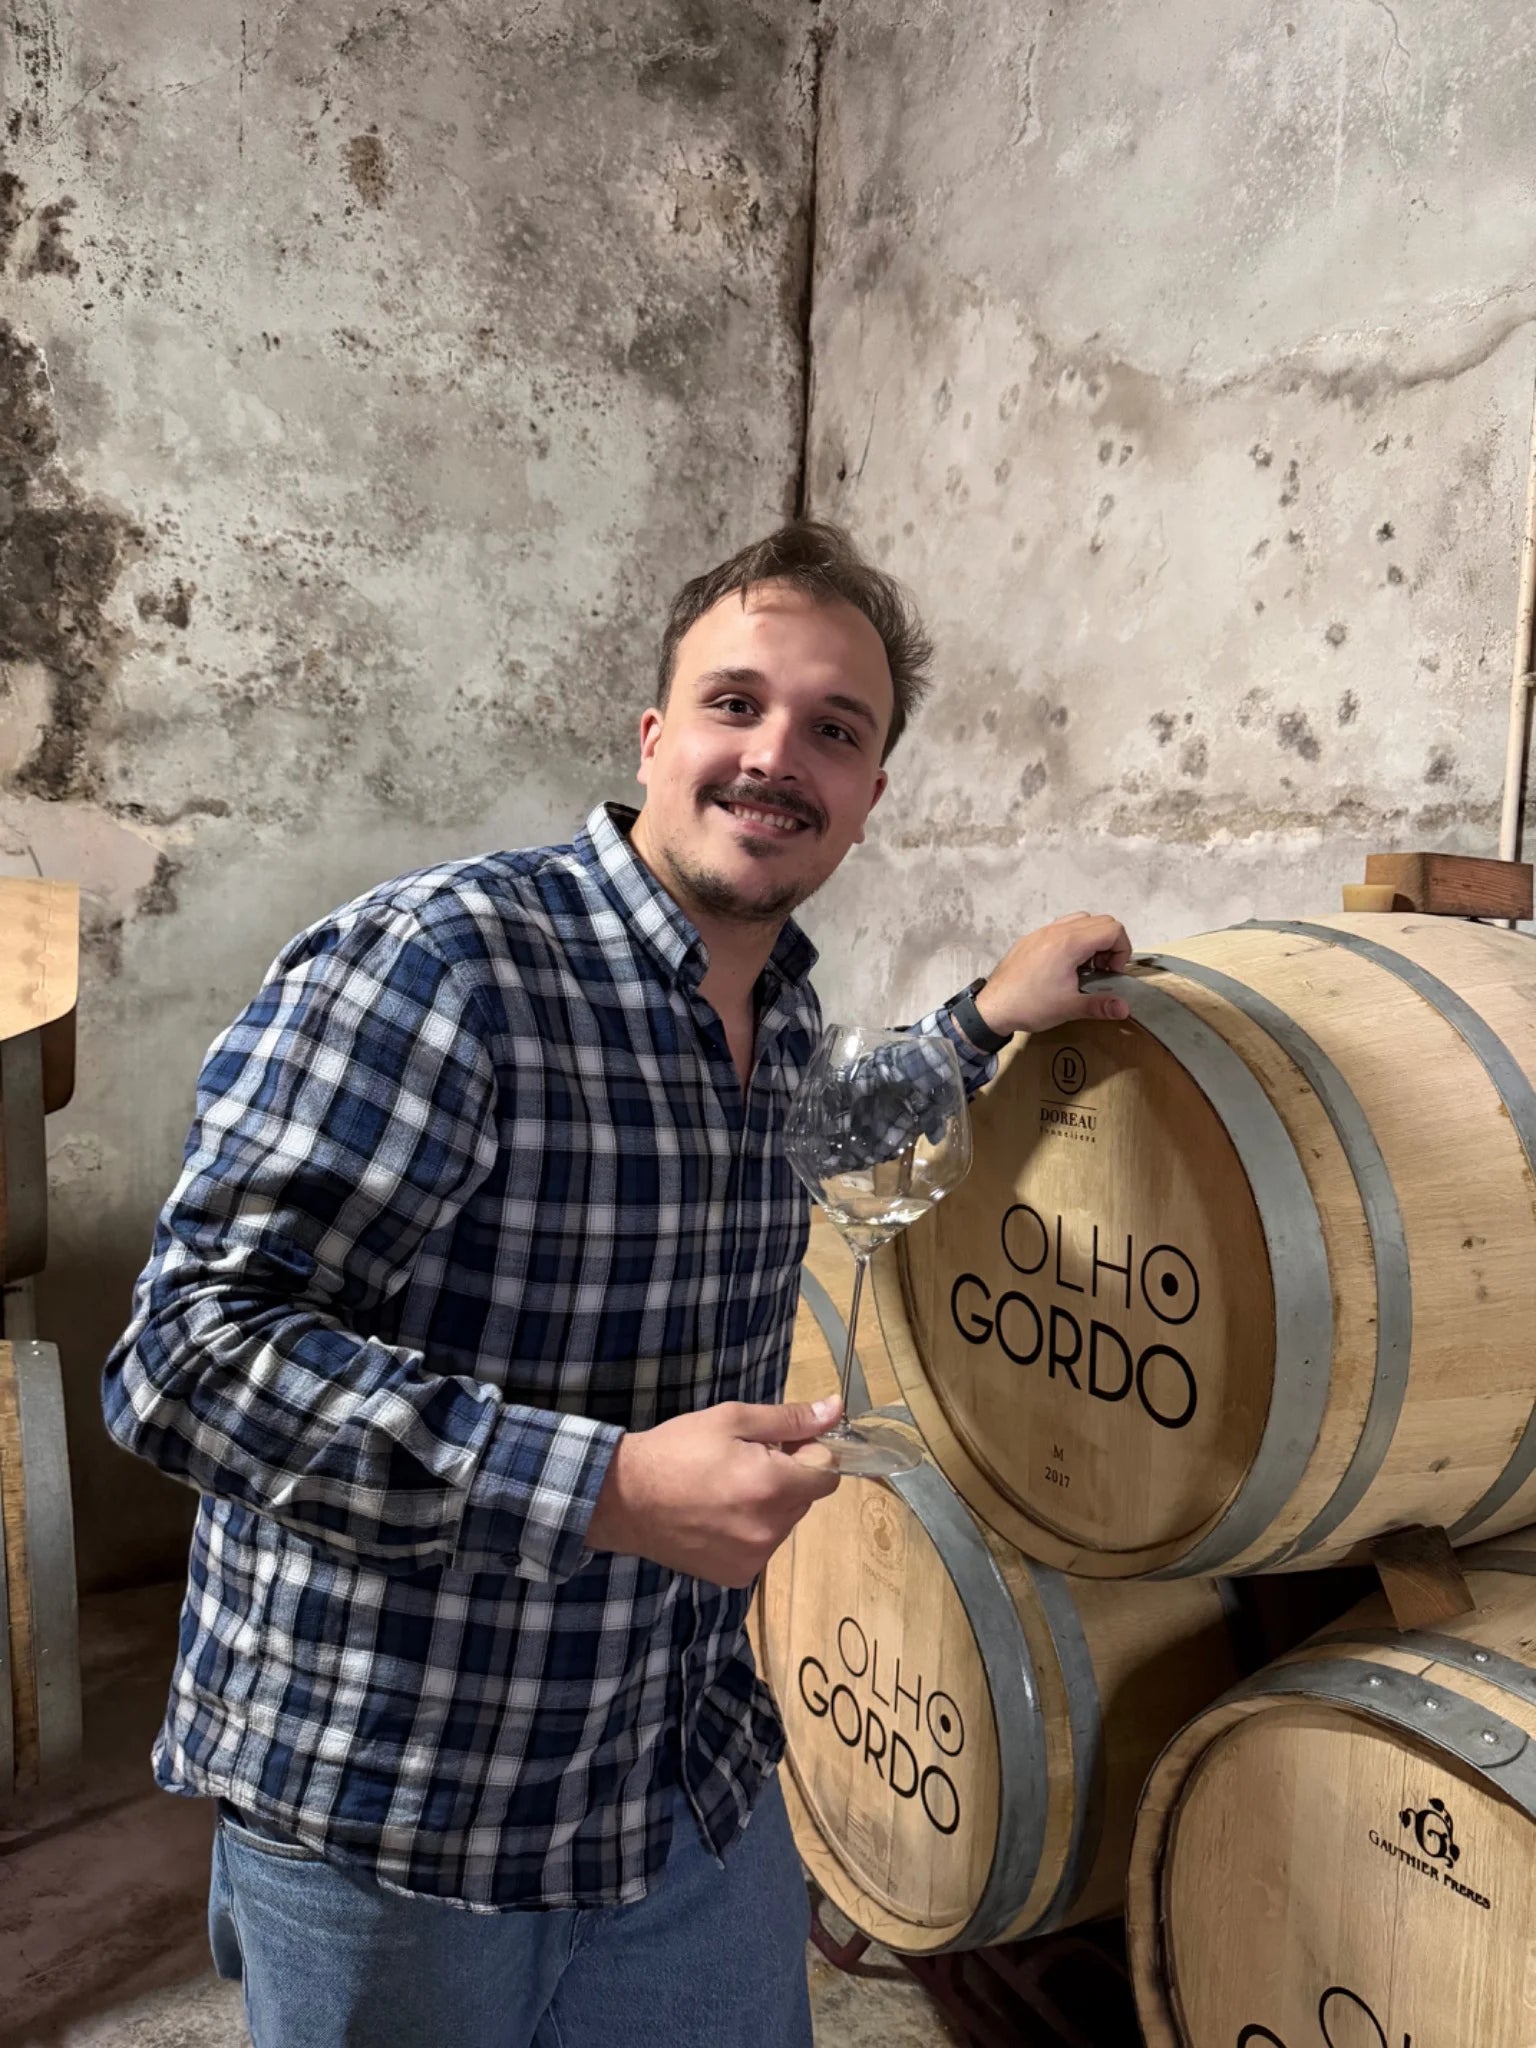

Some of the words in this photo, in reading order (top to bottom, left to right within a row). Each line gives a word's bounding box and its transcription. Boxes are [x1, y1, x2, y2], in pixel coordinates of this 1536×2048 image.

[1040, 1107, 1097, 1131] DOREAU
[1001, 1203, 1200, 1326] OLHO
[950, 1272, 1198, 1429] GORDO
[1044, 1466, 1071, 1488] 2017
[1053, 1444, 1064, 1462] M
[838, 1616, 965, 1757] OLHO
[798, 1656, 960, 1835] GORDO
[1368, 1829, 1440, 1881] GAUTHIER
